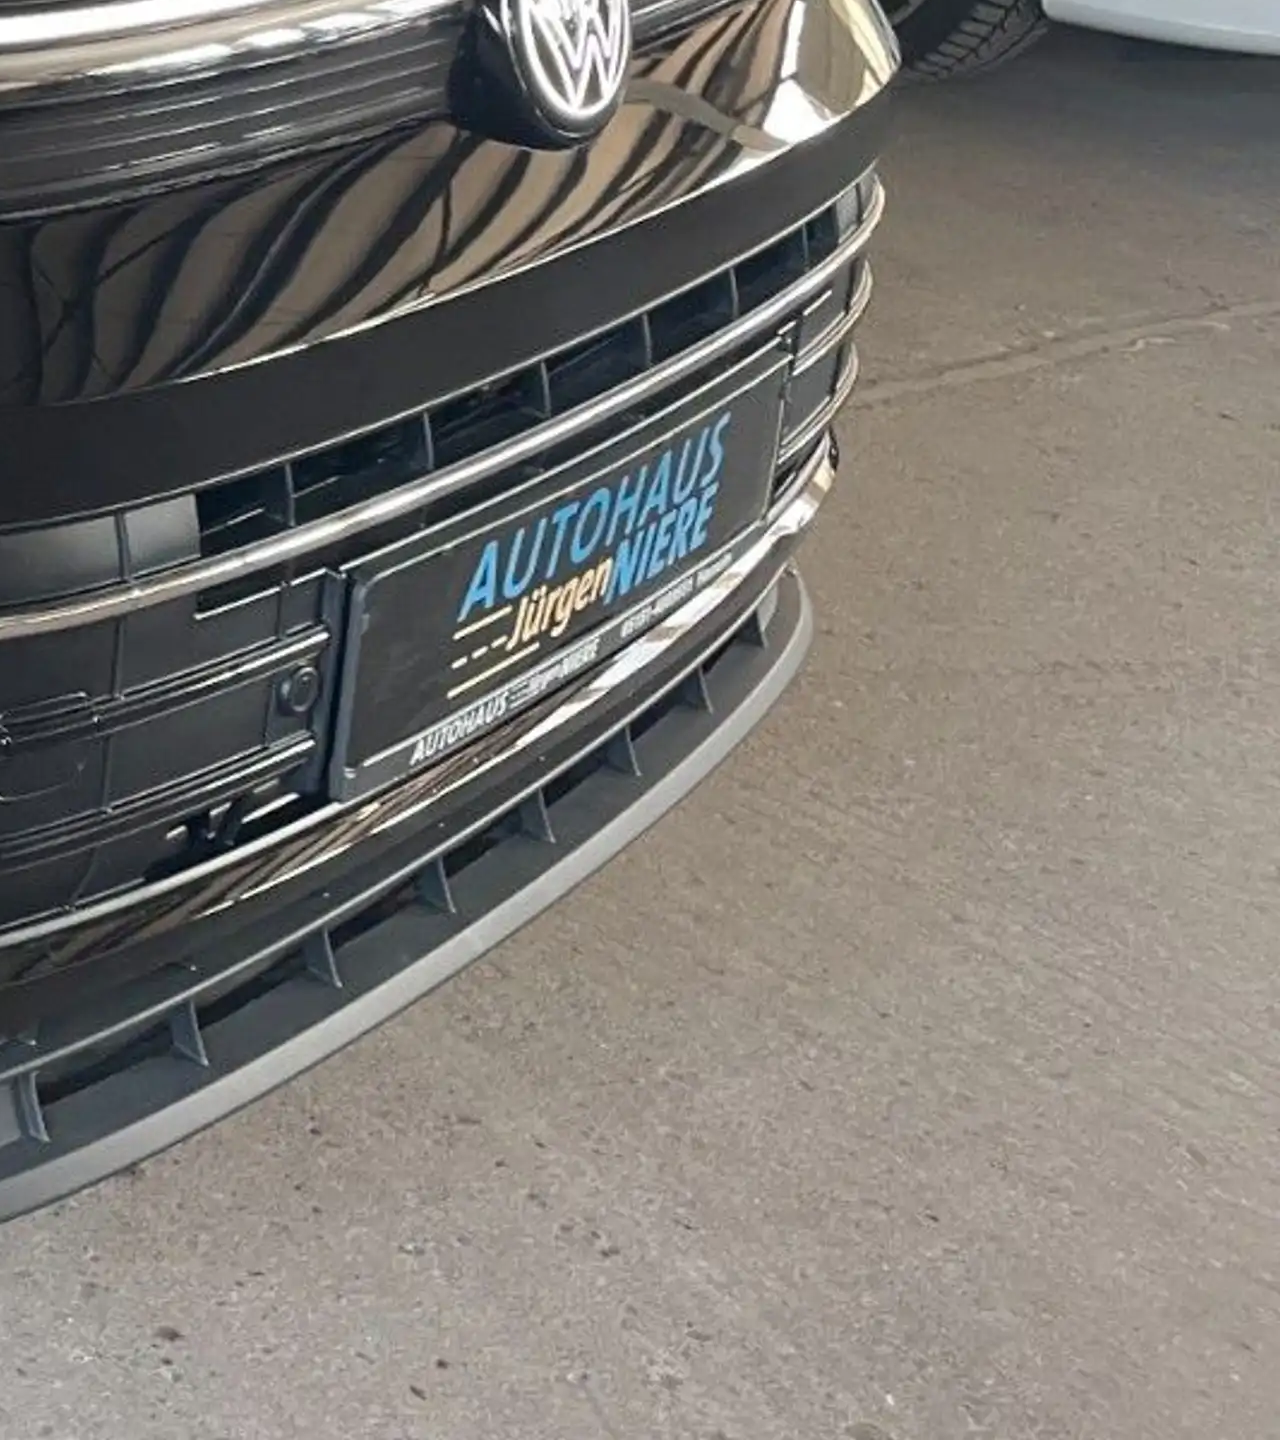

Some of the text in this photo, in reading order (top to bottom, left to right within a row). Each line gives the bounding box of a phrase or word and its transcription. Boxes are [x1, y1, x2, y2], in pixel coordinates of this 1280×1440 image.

[457, 411, 731, 623] AUTOHAUS
[505, 557, 614, 651] Jürgen
[603, 481, 719, 606] NIERE
